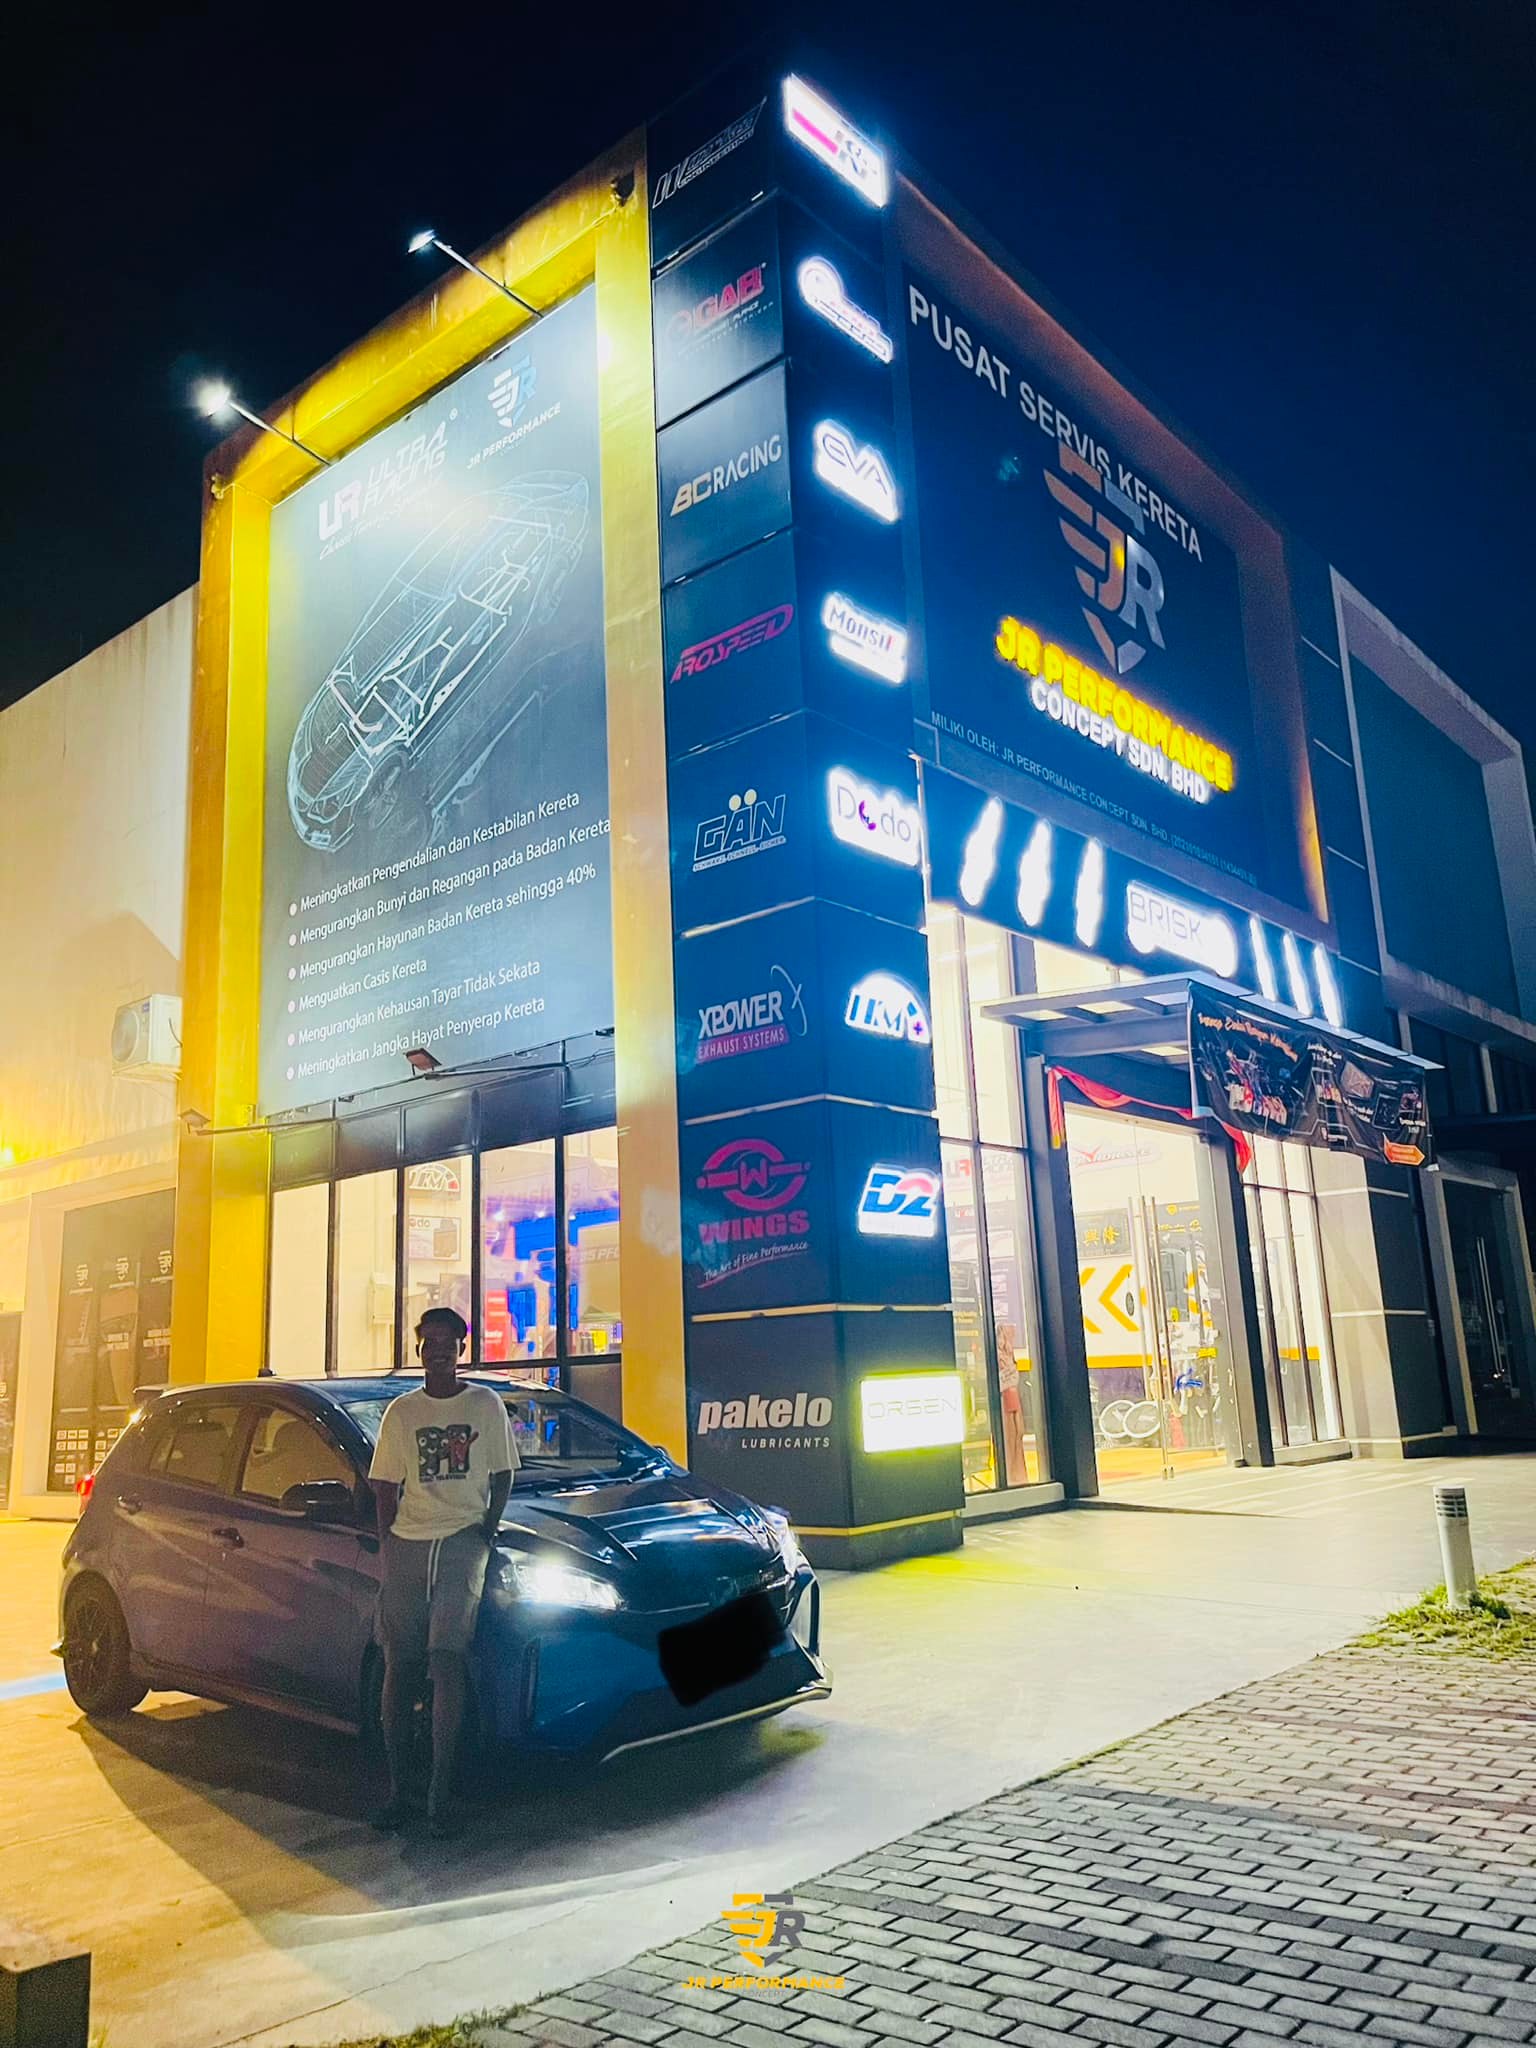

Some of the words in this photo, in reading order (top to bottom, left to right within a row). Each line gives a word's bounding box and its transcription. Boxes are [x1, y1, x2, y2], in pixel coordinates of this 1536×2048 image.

[481, 401, 561, 462] PERFORMANCE
[909, 285, 1010, 398] PUSAT
[1019, 382, 1112, 481] SERVIS
[1118, 463, 1203, 563] KERETA
[713, 434, 783, 494] RACING
[995, 615, 1042, 677] JR
[1043, 642, 1235, 792] PERFORMANCE
[931, 711, 965, 739] MILIKI
[967, 728, 999, 757] OLEH:
[1002, 747, 1016, 764] JR
[1016, 754, 1088, 801] PERFORMANCE
[1088, 791, 1129, 824] CONCEPT
[1030, 679, 1129, 758] CONCEPT
[1171, 763, 1210, 806] BHD
[300, 873, 371, 913] Meningkatkan
[373, 844, 446, 886] Pengendalian
[448, 835, 471, 857] dan
[473, 809, 535, 846] Kestabilan
[538, 791, 580, 818] Kereta
[300, 901, 375, 946] Mengurangkan
[377, 894, 407, 918] Bunyi
[408, 883, 431, 905] dan
[432, 863, 490, 899] Regangan
[492, 849, 523, 875] pada
[526, 832, 565, 863] Badan
[568, 816, 611, 847] Kereta
[300, 939, 375, 980] Mengurangkan
[377, 924, 425, 956] Hayunan
[427, 911, 463, 935] Badan
[465, 895, 504, 923] Kereta
[506, 875, 564, 911] sehingga
[567, 863, 596, 887] 40%
[298, 1008, 374, 1047] Mengurangkan
[377, 996, 430, 1024] Kehausan
[432, 982, 463, 1008] Tayar
[464, 970, 496, 995] Tidak
[498, 959, 541, 985] Sekata
[299, 980, 361, 1015] Menguatkan
[363, 970, 390, 992] Casis
[392, 958, 427, 980] Kereta
[698, 990, 784, 1040] XPOWER
[298, 1041, 369, 1081] Meningkatkan
[371, 1032, 409, 1060] Jangka
[412, 1020, 444, 1048] Hayat
[446, 1007, 502, 1041] Penyerap
[504, 996, 545, 1020] Kereta
[697, 1035, 742, 1060] EXHAUST
[743, 1028, 785, 1051] SYSTEMS
[862, 1171, 939, 1218] D2
[698, 1211, 810, 1245] WINGS
[760, 1240, 809, 1261] Performance
[697, 1392, 833, 1436] pakelo
[741, 1436, 831, 1449] LUBRICANTS
